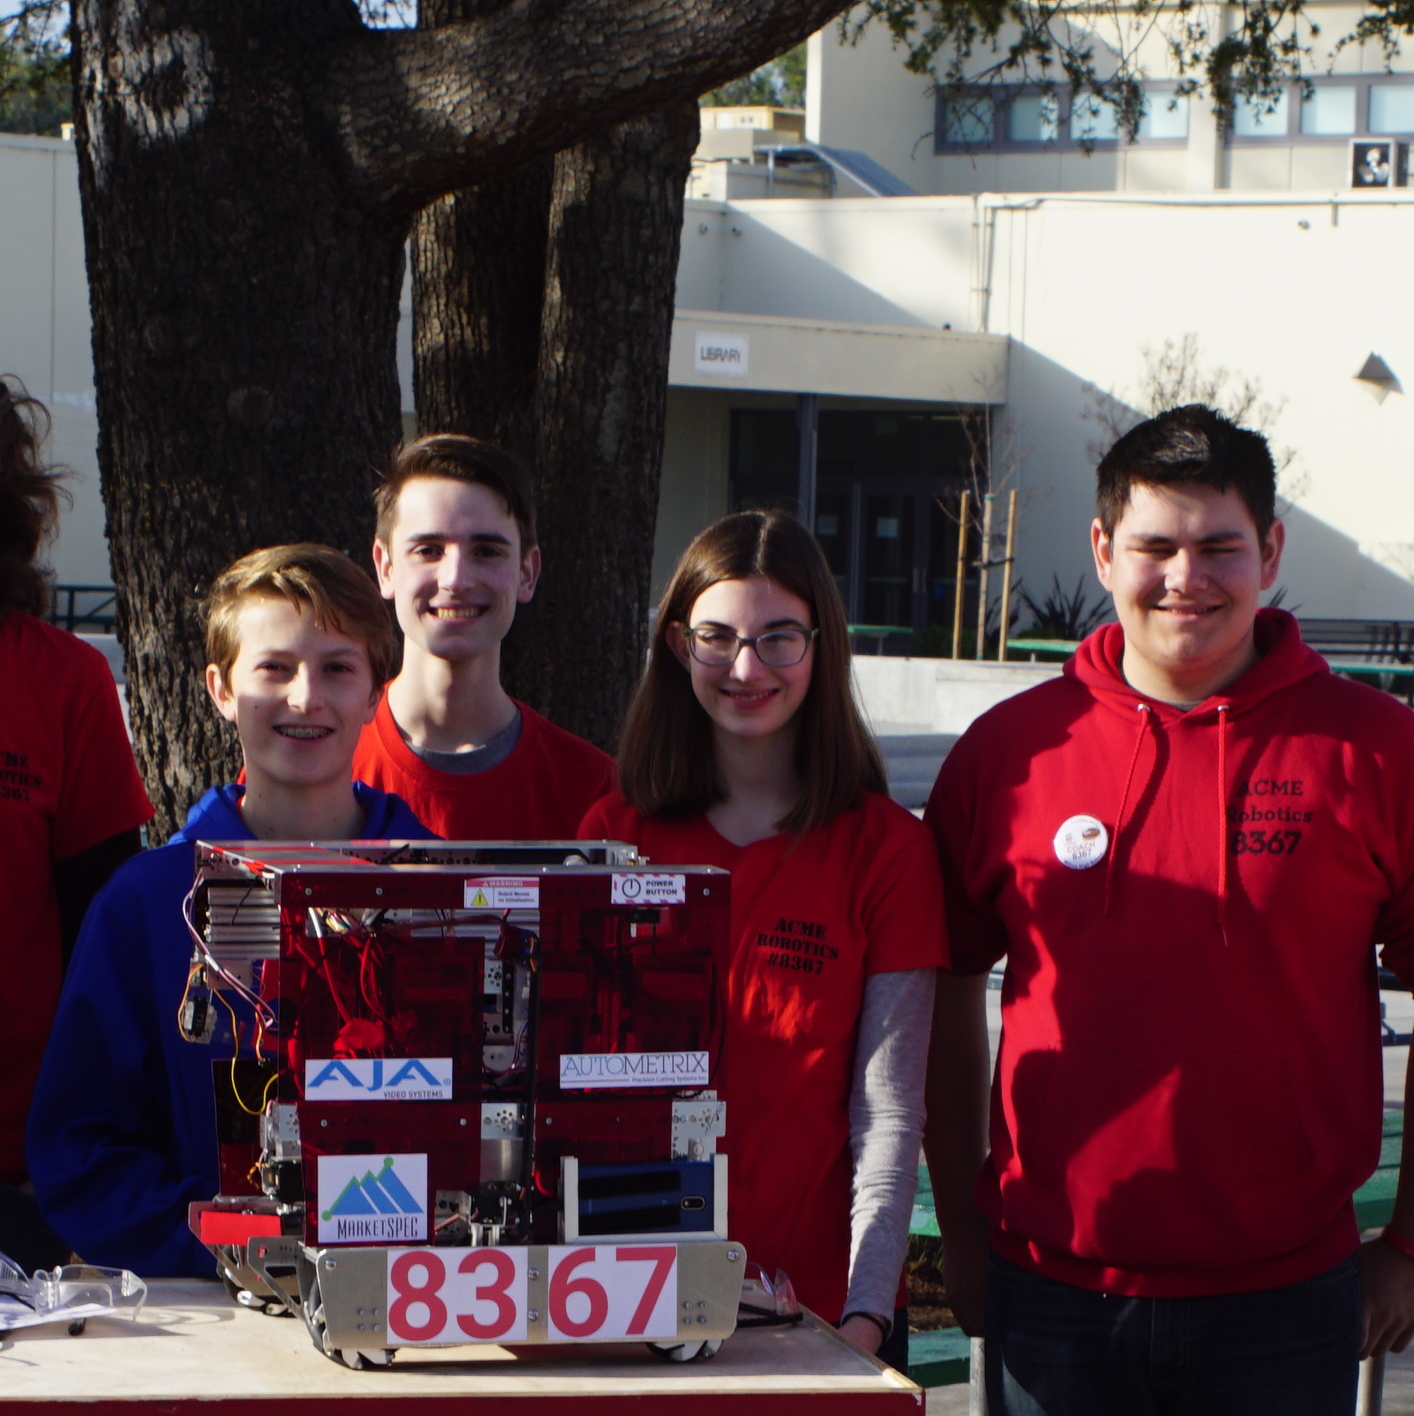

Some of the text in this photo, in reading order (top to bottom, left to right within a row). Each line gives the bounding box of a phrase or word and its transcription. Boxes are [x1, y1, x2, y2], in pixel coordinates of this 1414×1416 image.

[700, 346, 740, 362] LIBRARY
[1236, 780, 1303, 797] ACME
[1226, 806, 1313, 823] Robotics
[1067, 841, 1096, 853] COACH
[1231, 830, 1302, 855] 8367
[1072, 849, 1091, 860] 8367
[645, 888, 678, 896] BUTTON
[775, 918, 827, 939] ACME
[756, 933, 839, 959] ROBOTICS
[768, 951, 824, 975] #8367
[561, 1053, 707, 1076] AUTOMETRIX
[307, 1060, 443, 1092] AJA
[676, 1075, 697, 1083] Systems
[383, 1090, 443, 1099] VIDEO SYSTEMS
